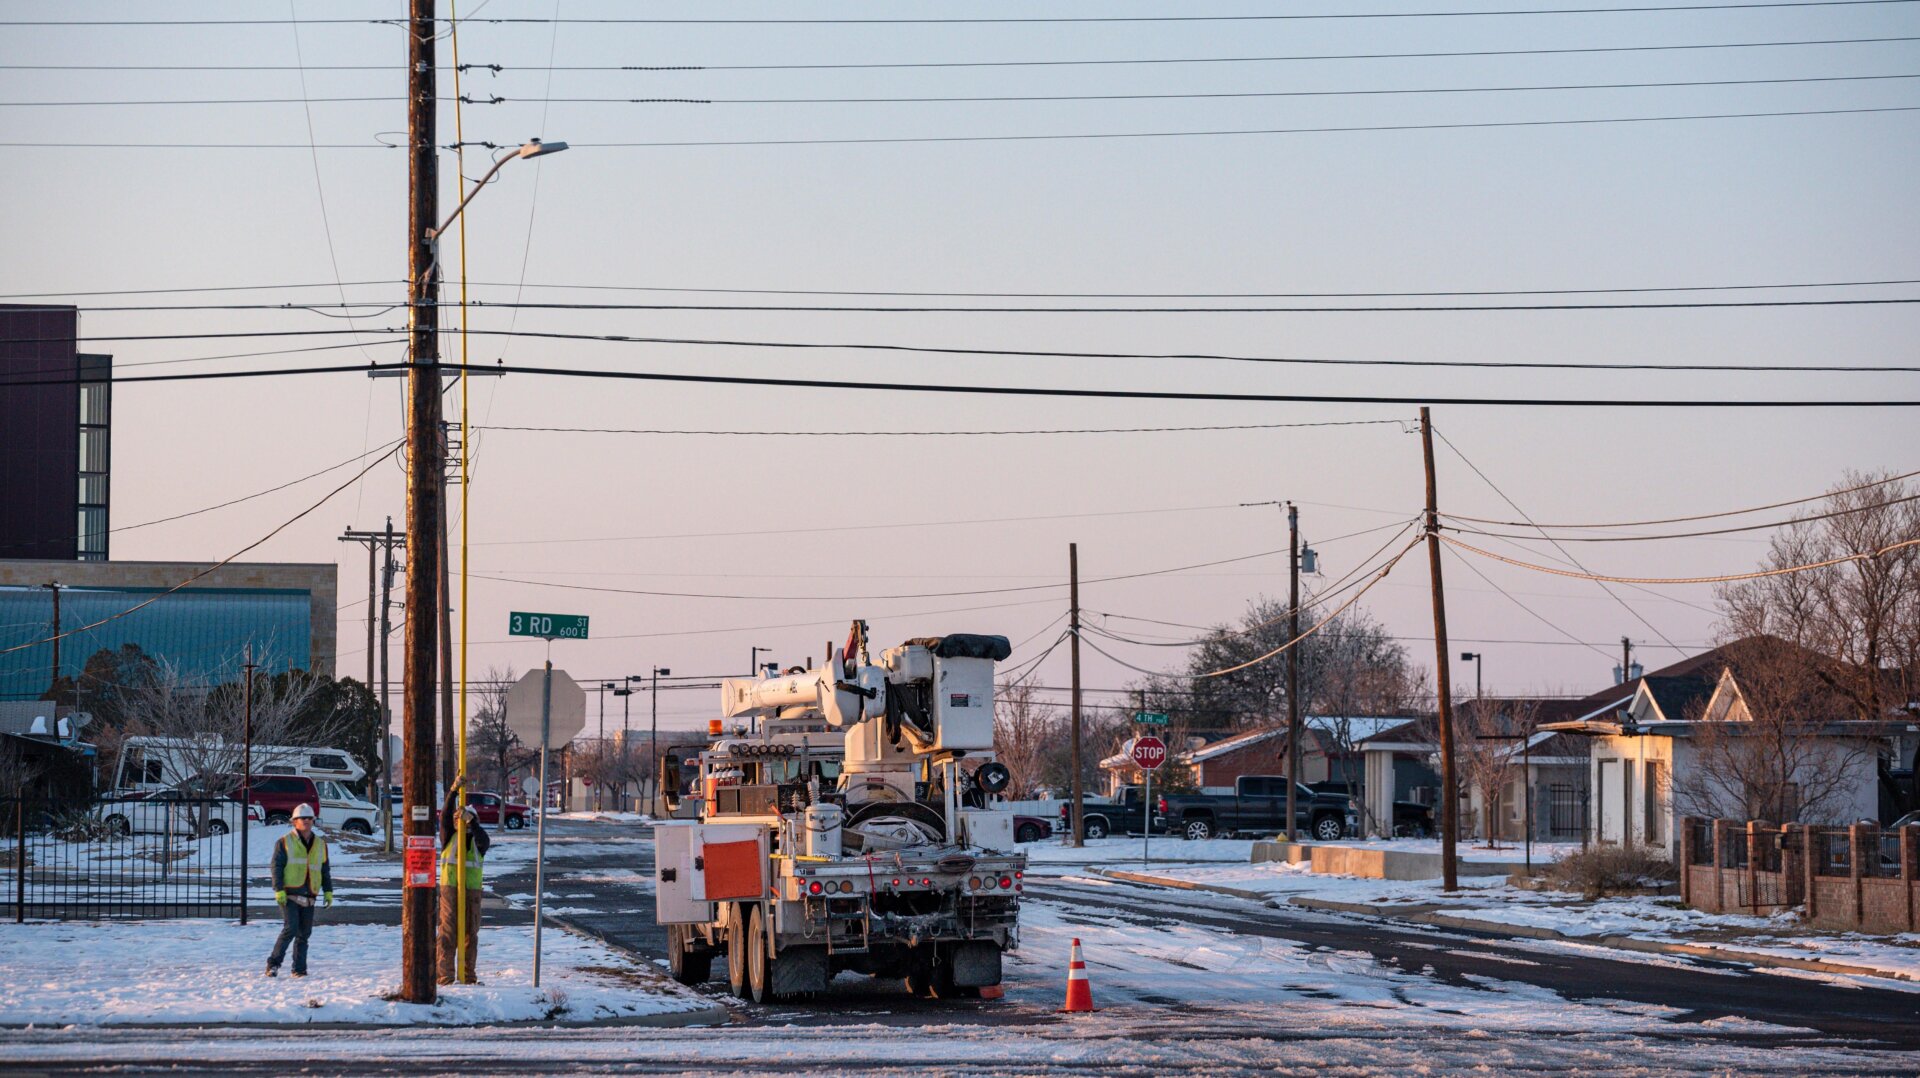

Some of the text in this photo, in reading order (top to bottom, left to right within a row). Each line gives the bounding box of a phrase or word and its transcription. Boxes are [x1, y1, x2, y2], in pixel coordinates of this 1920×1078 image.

[512, 615, 552, 634] 3 RD
[577, 618, 588, 627] ST
[560, 627, 587, 637] 600 E
[1136, 714, 1153, 722] 4 TH
[1135, 746, 1164, 759] STOP
